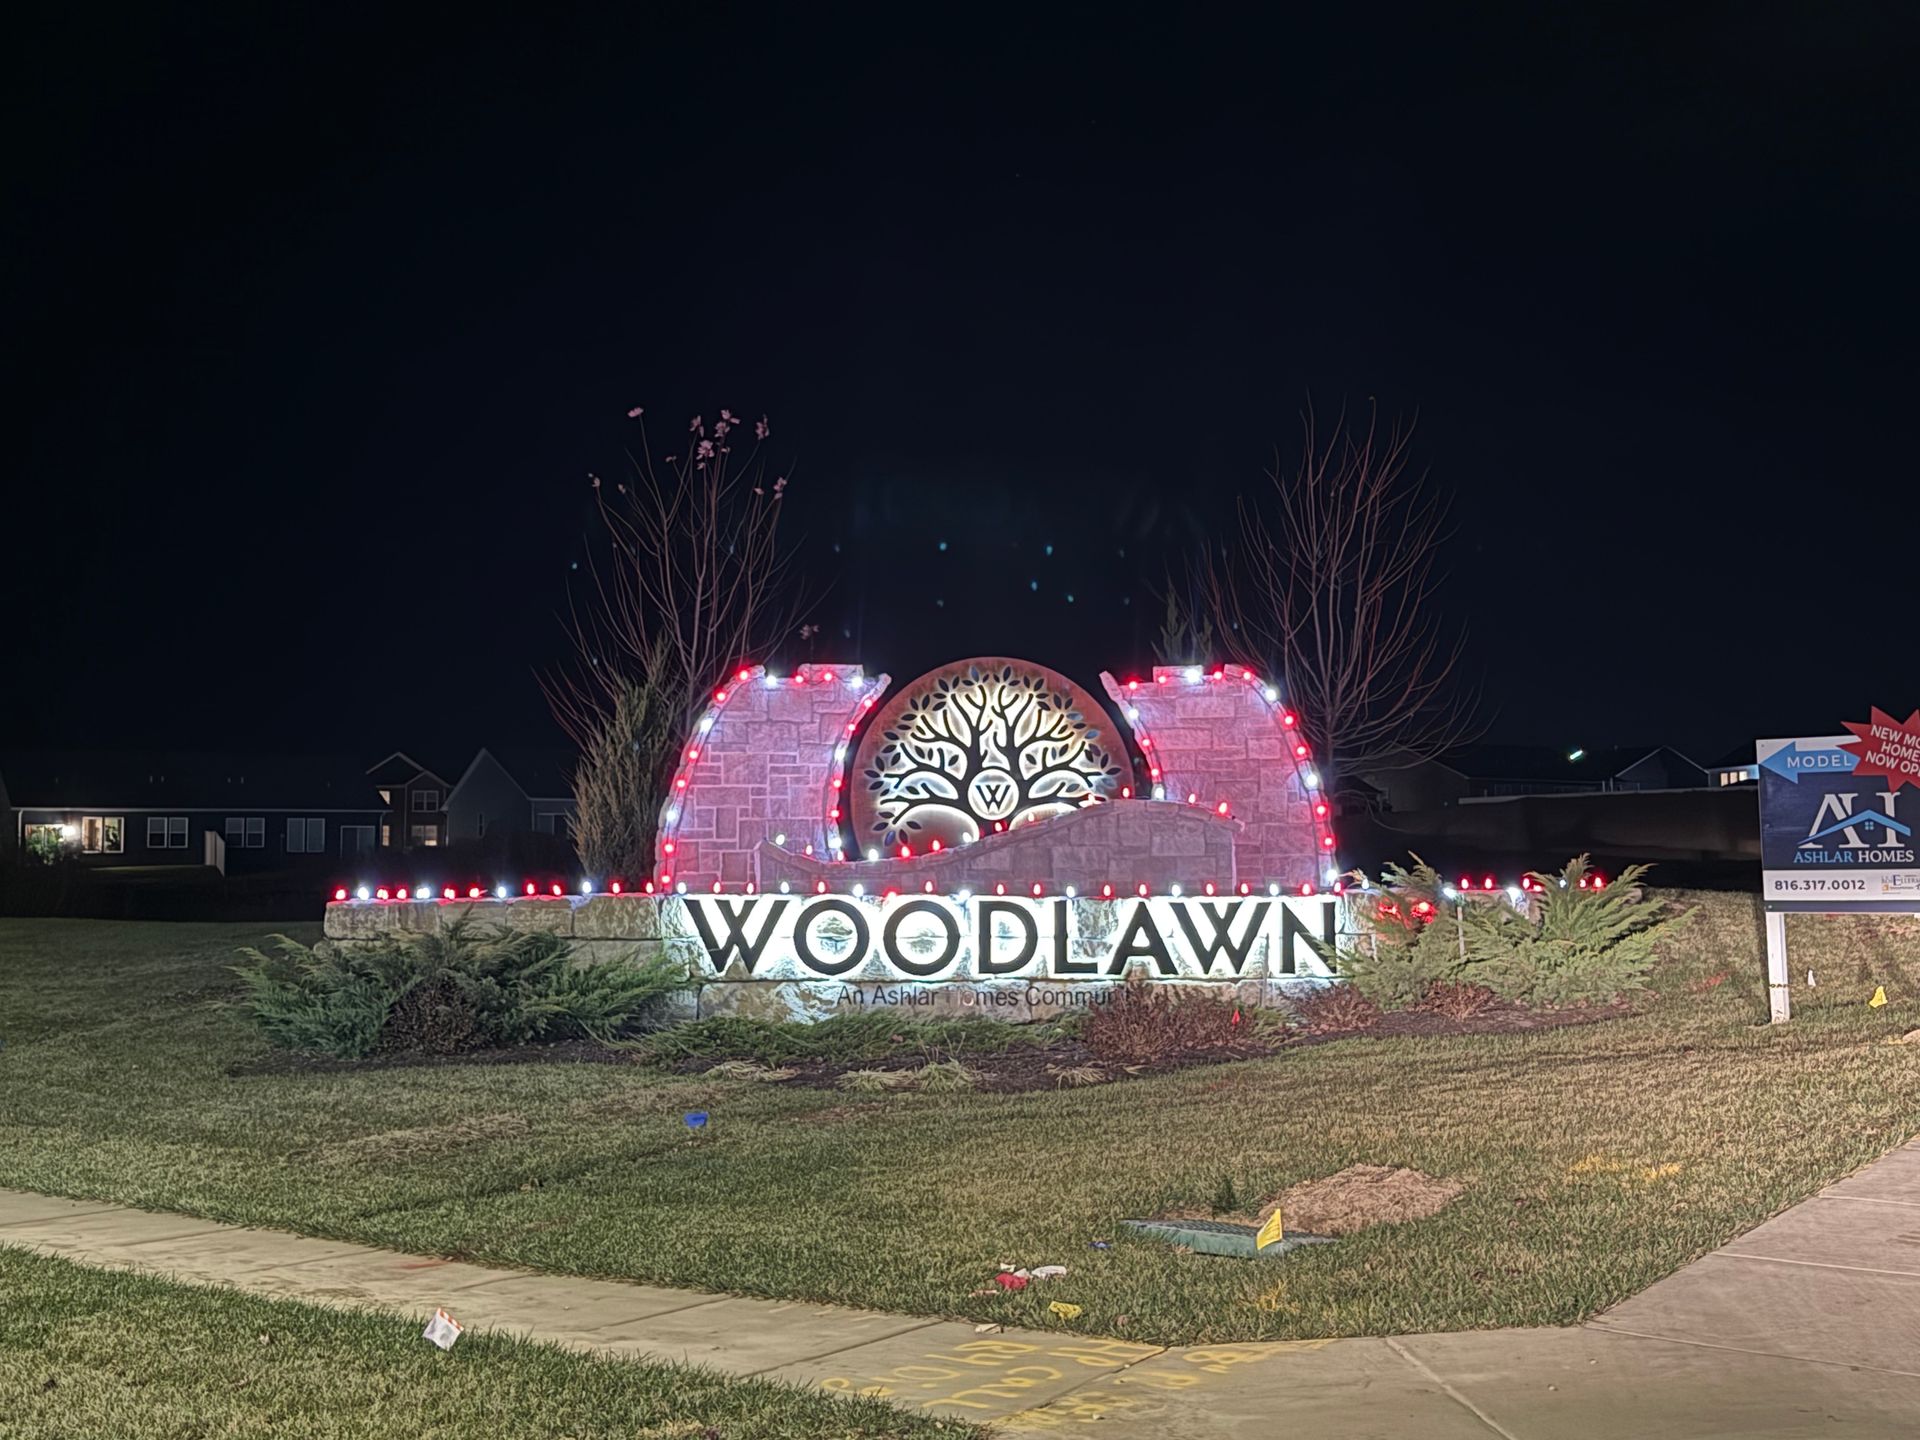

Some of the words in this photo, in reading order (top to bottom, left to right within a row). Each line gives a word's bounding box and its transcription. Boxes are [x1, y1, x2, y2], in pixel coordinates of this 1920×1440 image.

[1870, 724, 1903, 742] NEW
[1787, 754, 1852, 769] MODEL
[1880, 740, 1920, 763] HOME
[1865, 750, 1899, 770] NOW
[1900, 760, 1920, 777] OP
[975, 784, 1011, 812] W
[1793, 850, 1854, 863] ASHLAR
[1858, 850, 1915, 863] HOMES
[1774, 880, 1866, 891] 816.317.0012
[684, 899, 1337, 976] WOODLAWN
[838, 985, 864, 1006] An
[871, 984, 938, 1006] Ashlar
[1025, 985, 1132, 1006] Commun
